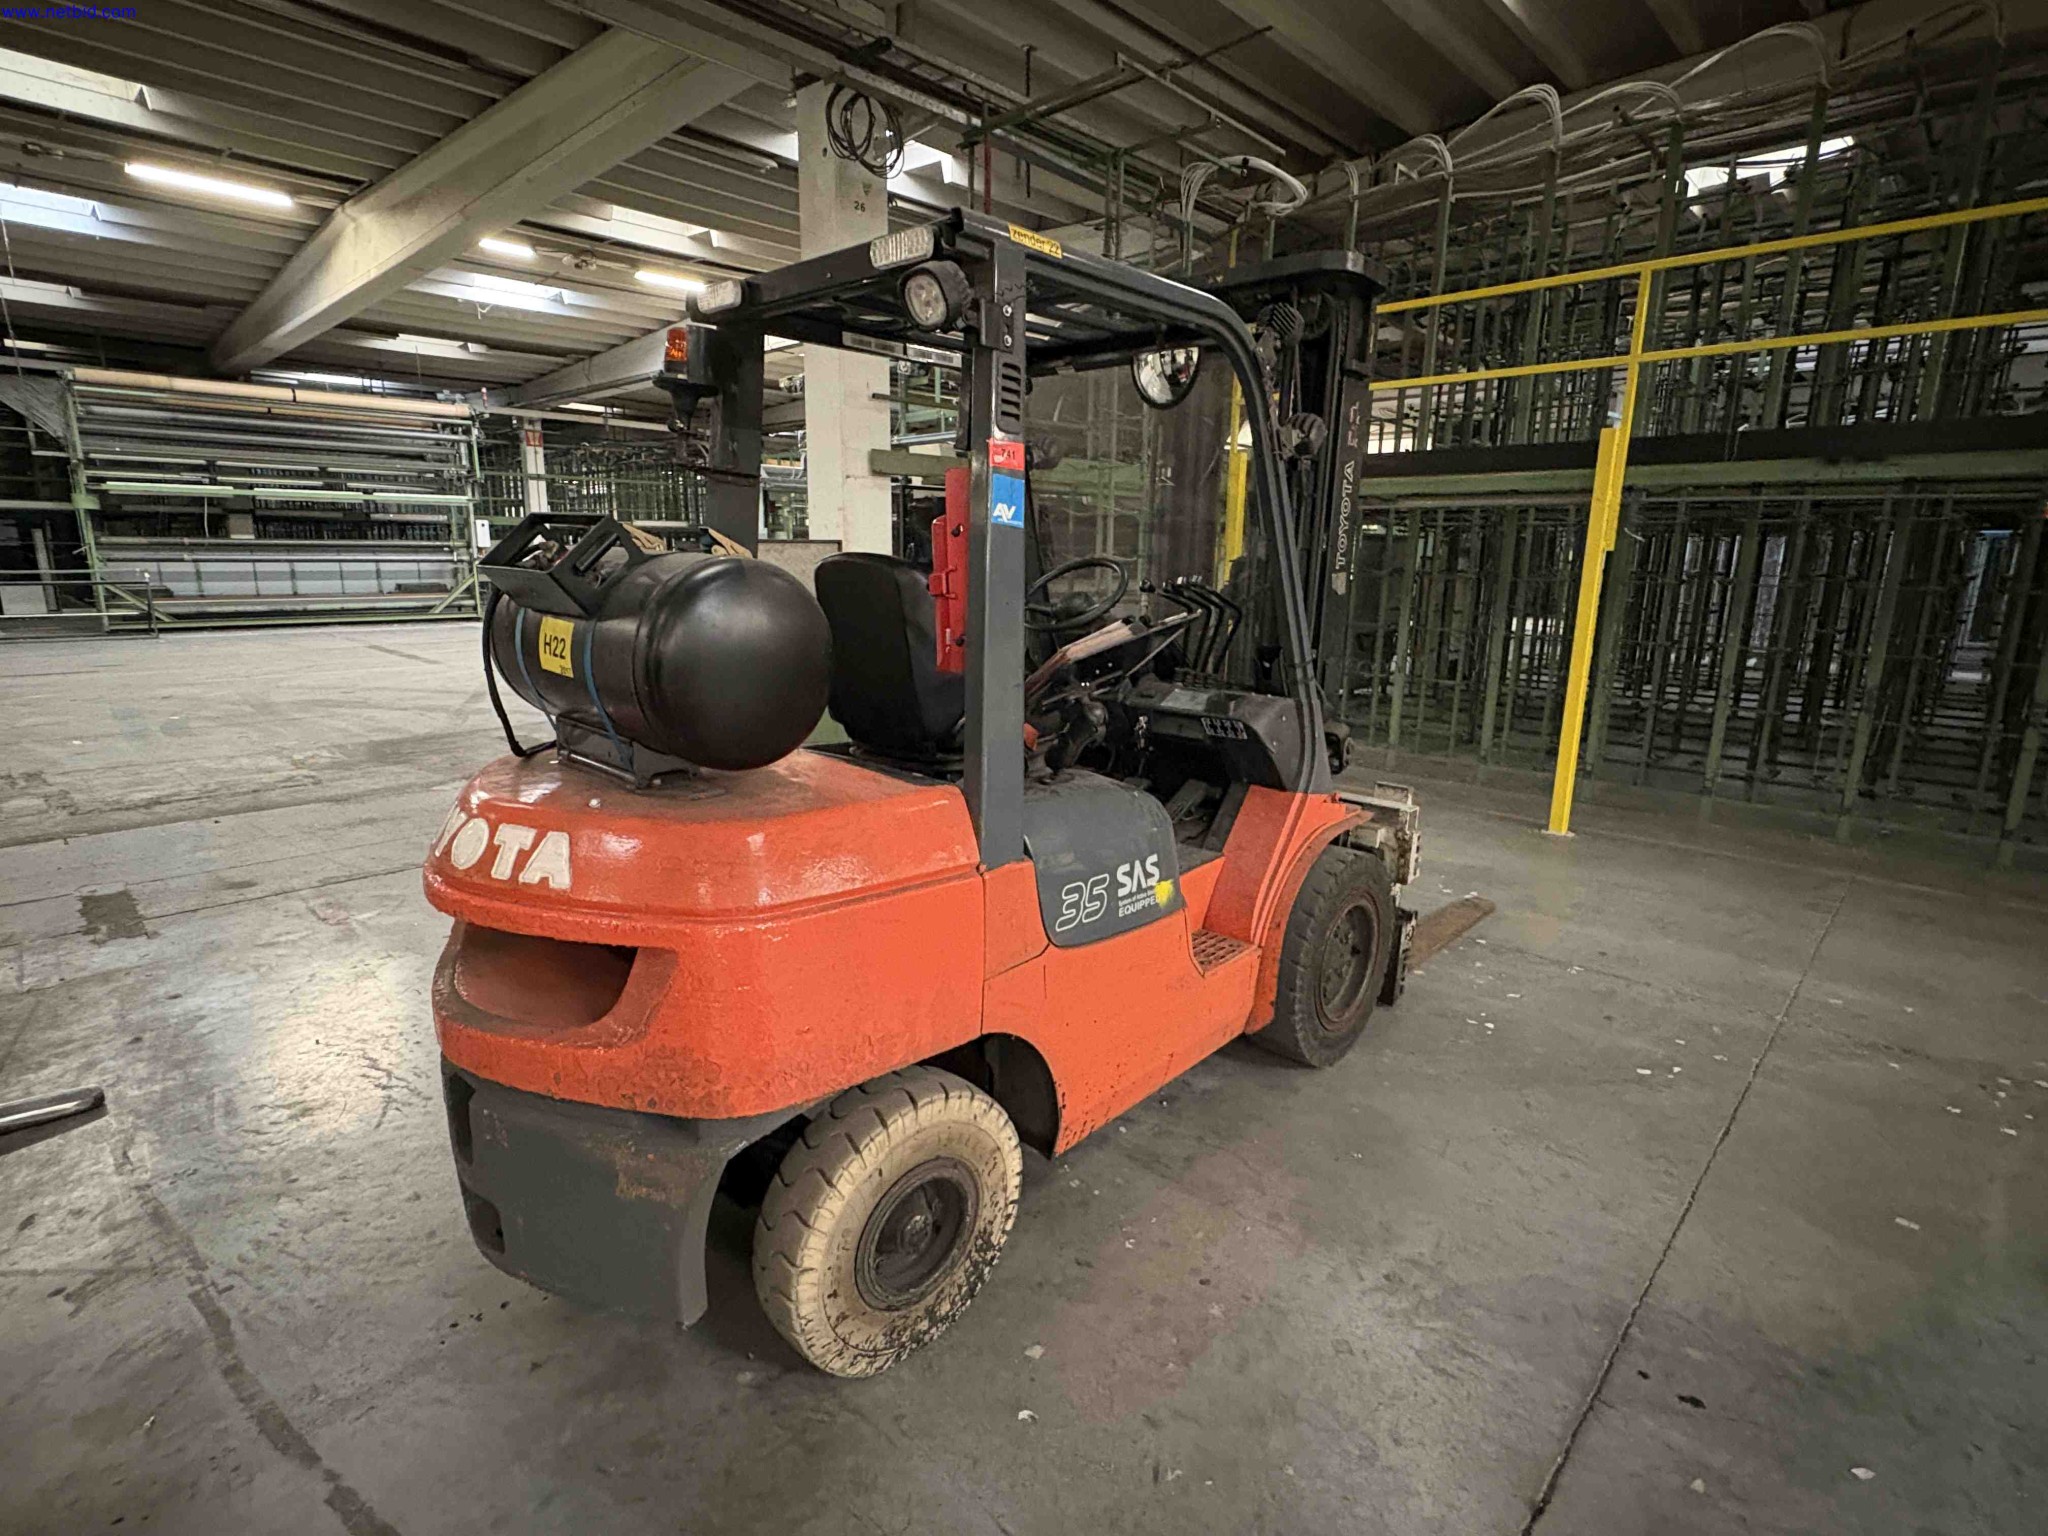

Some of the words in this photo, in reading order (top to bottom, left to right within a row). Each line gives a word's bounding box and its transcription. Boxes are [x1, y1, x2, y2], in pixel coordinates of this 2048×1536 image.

[853, 200, 866, 213] 26
[1335, 460, 1355, 570] TOYOTA
[543, 632, 567, 660] H22
[1116, 853, 1160, 897] SAS
[1055, 873, 1110, 932] 35
